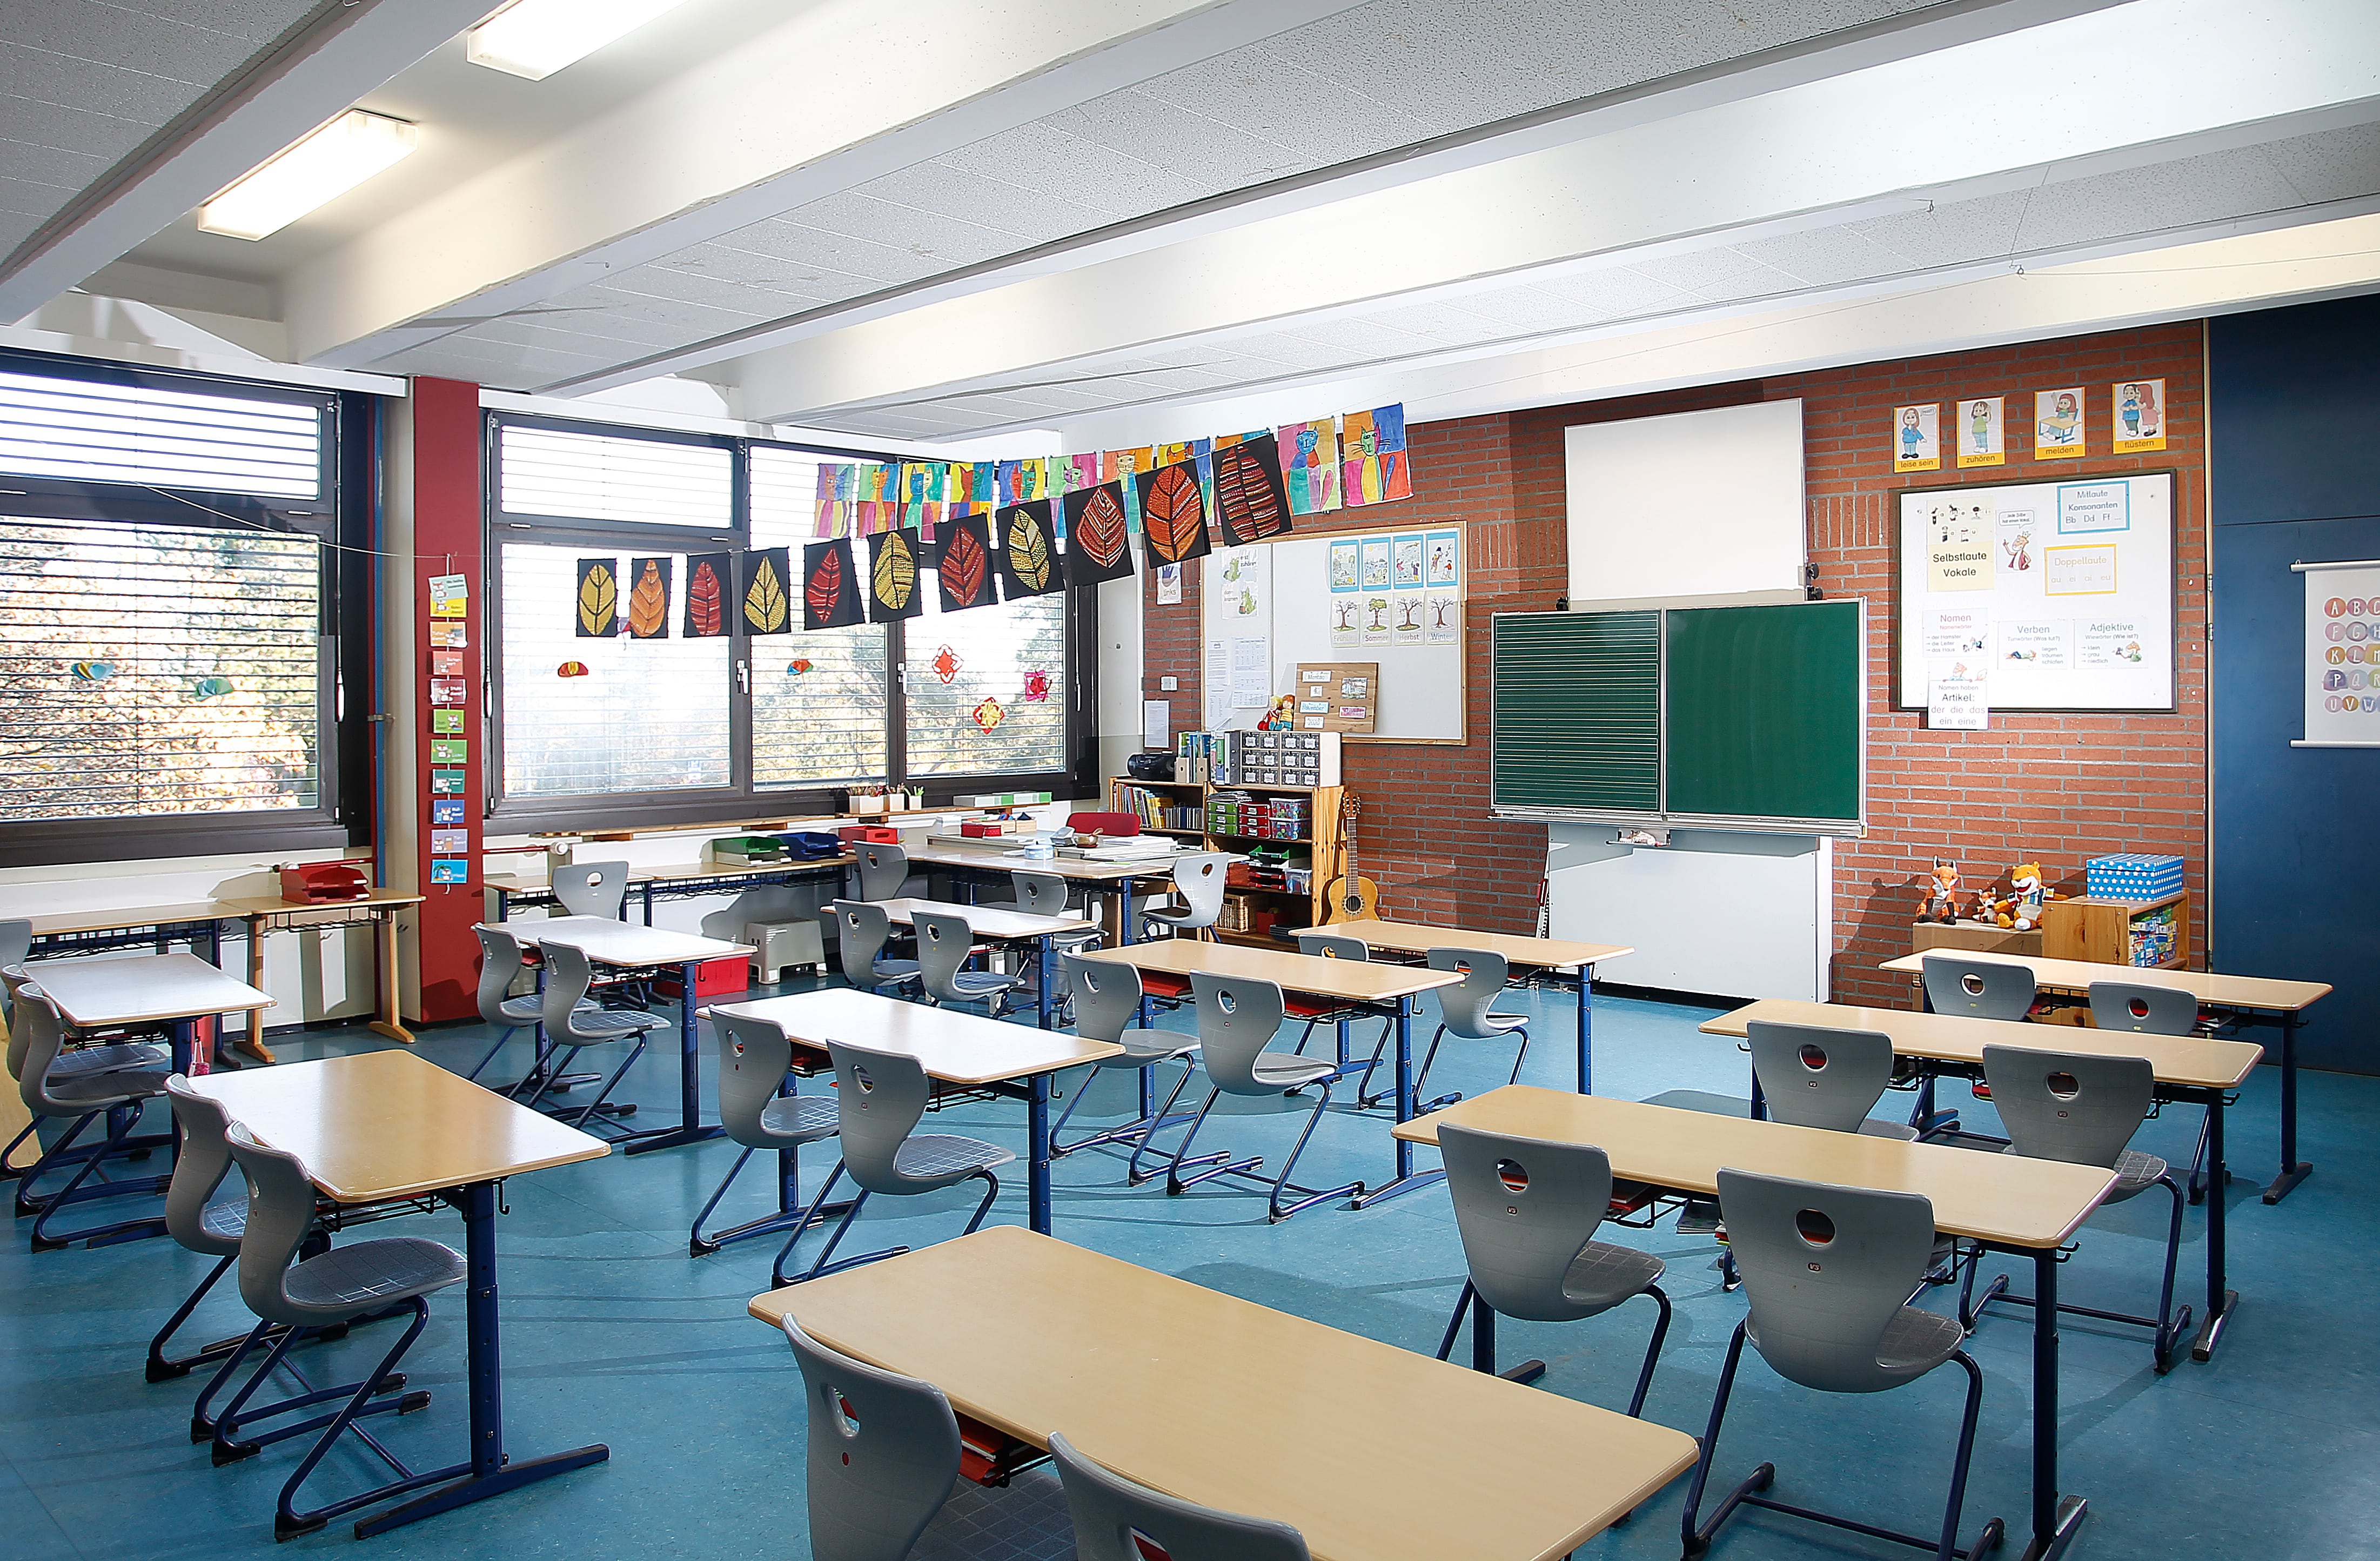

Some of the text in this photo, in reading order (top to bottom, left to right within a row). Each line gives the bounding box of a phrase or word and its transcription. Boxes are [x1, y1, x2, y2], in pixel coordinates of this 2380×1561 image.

[2124, 440, 2154, 448] flüstern
[2046, 447, 2074, 455] melden
[1966, 455, 1995, 463] zuhören
[2077, 490, 2108, 498] Mitlaute
[2068, 501, 2118, 511] Konsonanten
[2066, 515, 2076, 524] Bb
[1933, 552, 1987, 562] Selbstlaute
[2054, 556, 2107, 567] Doppellaute
[1943, 567, 1976, 577] Vokale
[2331, 600, 2380, 615] A B C
[2017, 625, 2050, 634] Verben
[2090, 623, 2134, 633] Adjektive
[2332, 626, 2338, 639] F
[2352, 625, 2360, 639] G
[2331, 649, 2339, 663] K
[2353, 649, 2361, 662] L
[2334, 673, 2380, 687] P Q R
[2330, 698, 2374, 711] U V W
